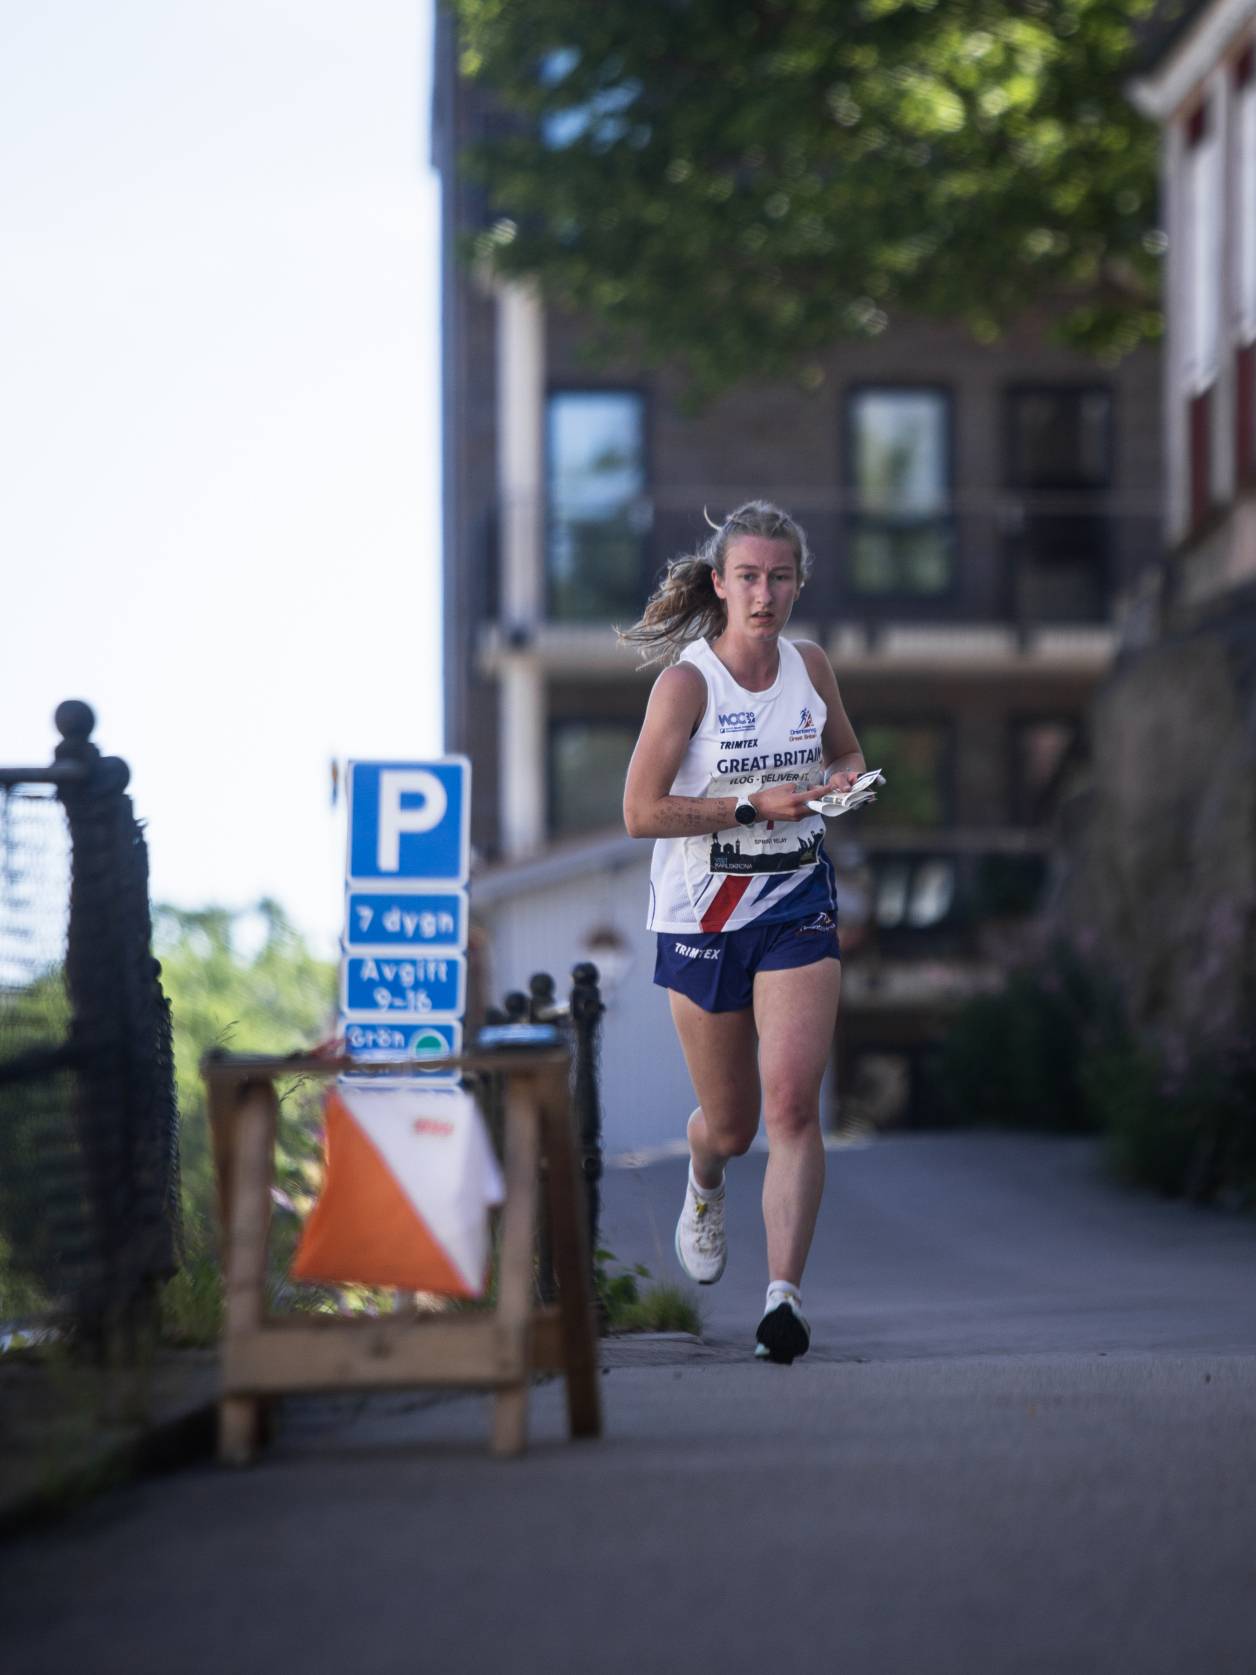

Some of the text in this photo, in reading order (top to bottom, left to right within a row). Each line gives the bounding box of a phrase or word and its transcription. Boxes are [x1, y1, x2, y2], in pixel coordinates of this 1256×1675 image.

[720, 738, 758, 750] TRIMTEX
[717, 754, 770, 774] GREAT
[761, 773, 799, 784] DELIVER
[378, 769, 448, 872] P
[355, 905, 454, 938] 7 dygn
[675, 942, 721, 960] TRIMTEX
[360, 958, 448, 988] Avgift
[349, 1025, 405, 1048] Grön
